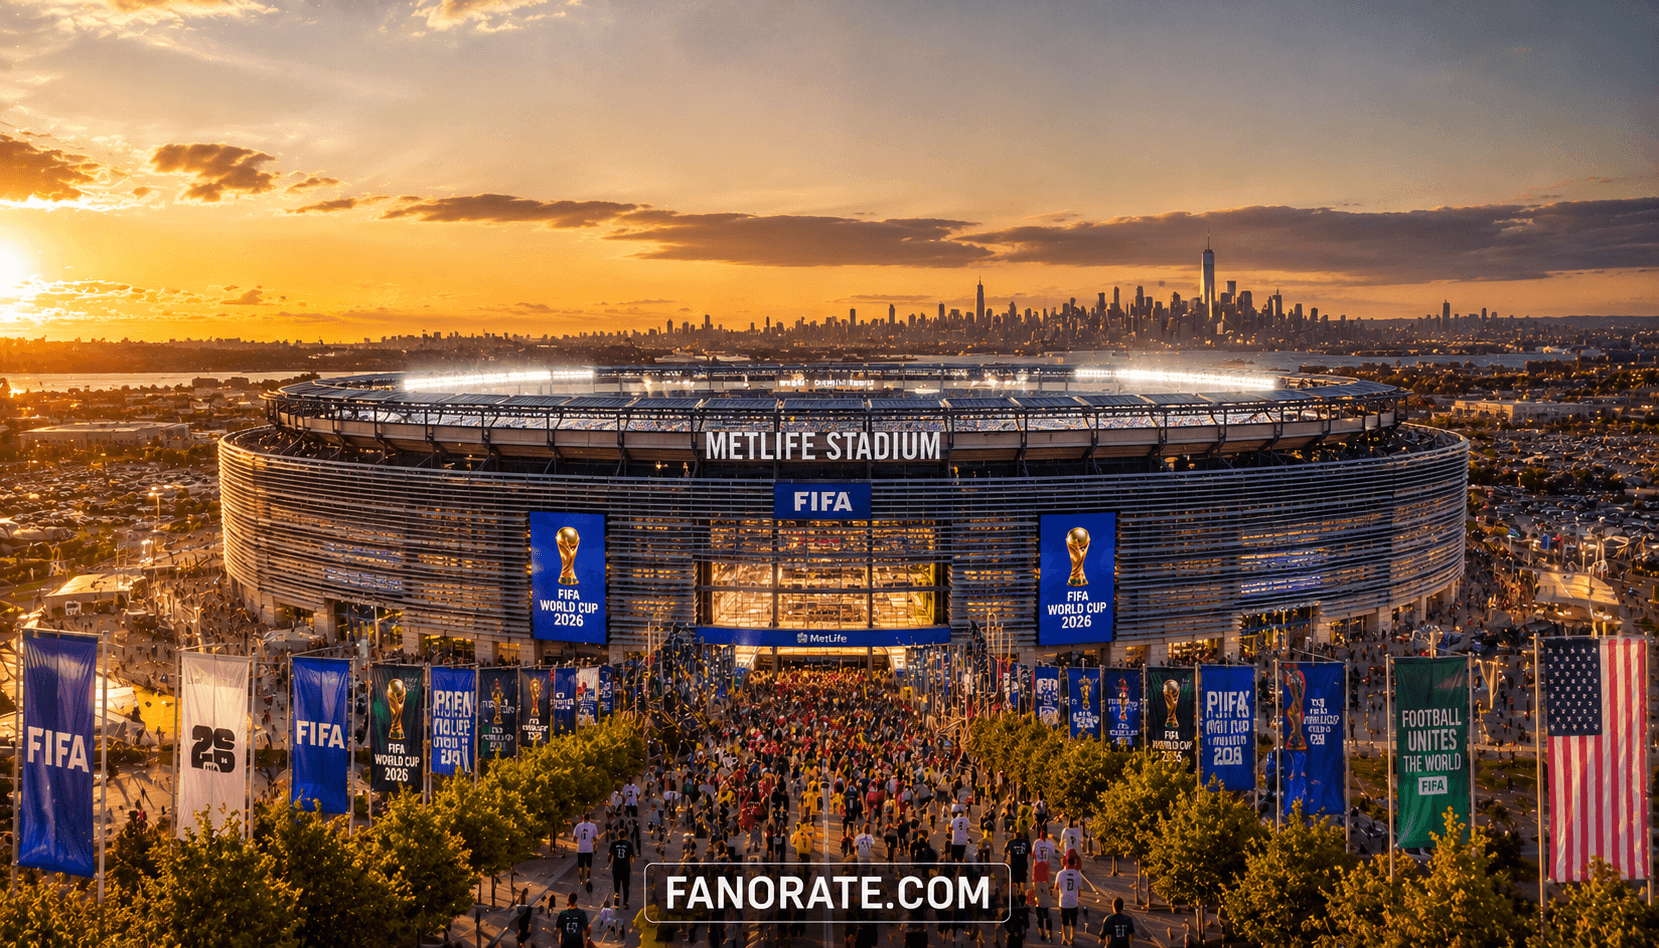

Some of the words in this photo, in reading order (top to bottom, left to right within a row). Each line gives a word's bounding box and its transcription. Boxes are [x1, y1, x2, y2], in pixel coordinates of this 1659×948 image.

[705, 432, 817, 460] METLIFE
[825, 431, 941, 460] STADIUM
[794, 491, 852, 512] FIFA
[557, 588, 580, 601] FIFA
[1066, 590, 1089, 602] FIFA
[540, 600, 576, 613] WORLD
[578, 601, 599, 614] CUP
[1047, 603, 1084, 616] WORLD
[1086, 601, 1107, 614] CUP
[554, 613, 584, 627] 2026
[1061, 615, 1092, 629] 2026
[810, 634, 847, 643] MetLife
[1402, 708, 1462, 727] FOOTBALL
[296, 719, 345, 749] FIFA
[1407, 728, 1457, 752] UNITES
[27, 726, 90, 773] FIFA
[190, 724, 236, 773] 26
[388, 743, 406, 755] FIFA
[405, 756, 420, 768] CUP
[1403, 755, 1422, 772] THE
[1425, 752, 1462, 772] WORLD
[384, 768, 409, 782] 2026
[1421, 779, 1445, 792] FIFA
